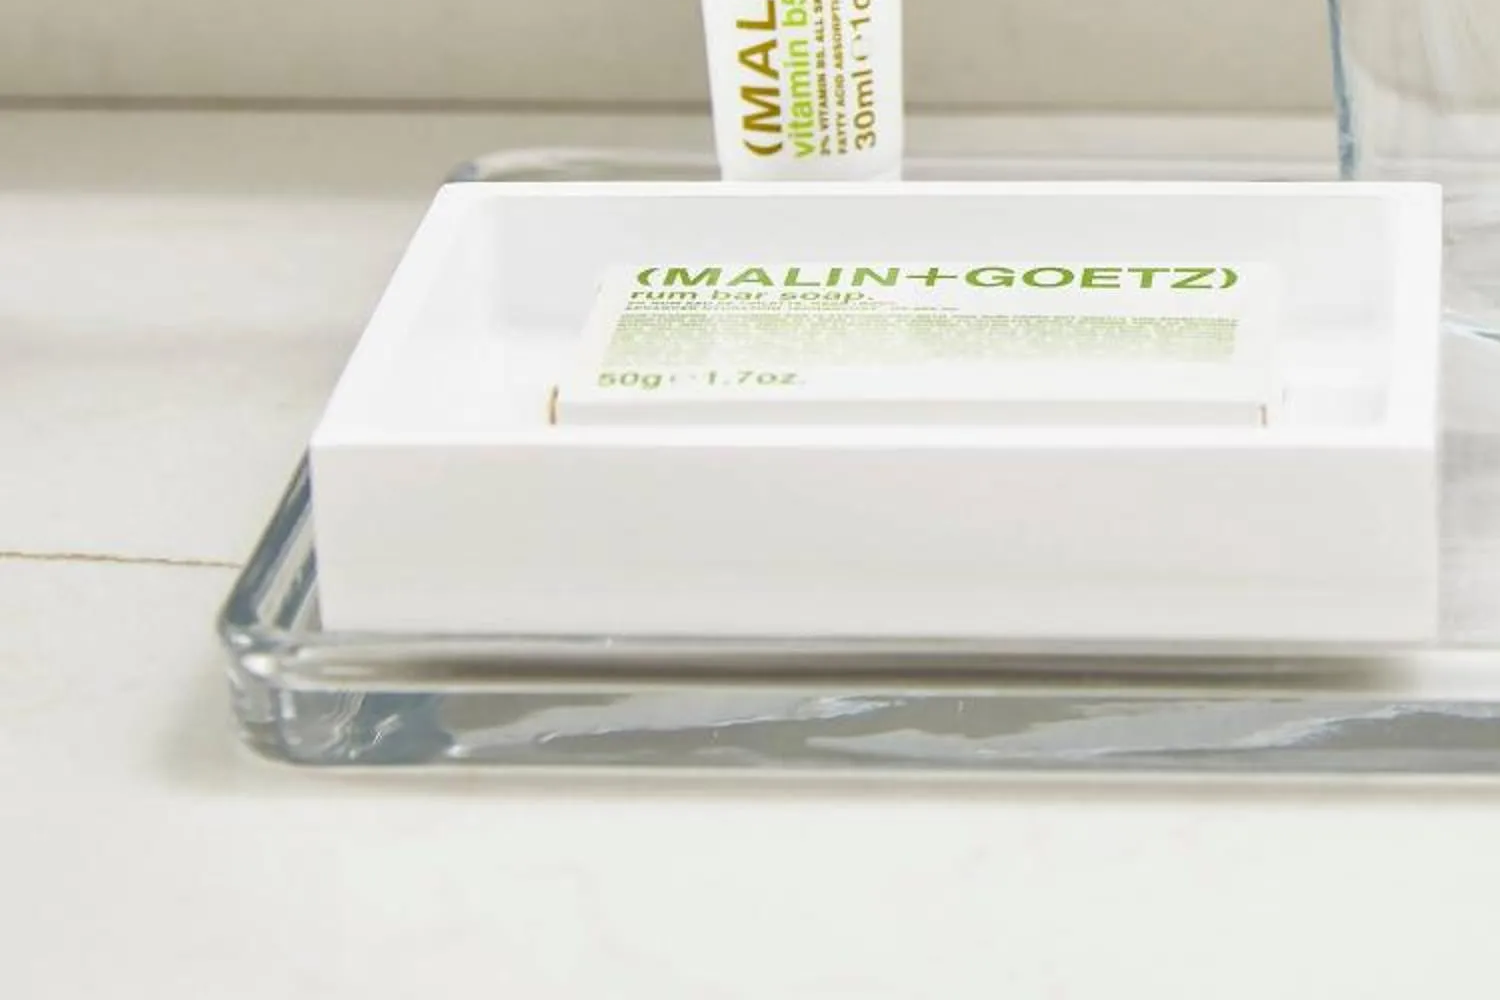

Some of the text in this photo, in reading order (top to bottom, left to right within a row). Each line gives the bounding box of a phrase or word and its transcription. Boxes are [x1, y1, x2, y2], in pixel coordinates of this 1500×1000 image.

[782, 38, 816, 158] vitamin
[833, 74, 846, 107] ACID
[852, 67, 877, 151] 30ml
[835, 112, 849, 155] FATTY
[636, 266, 1239, 289] (MALIN+GOETZ)
[630, 290, 698, 300] rum
[711, 289, 768, 300] bar
[779, 291, 876, 304] soap.
[598, 371, 663, 390] 50g
